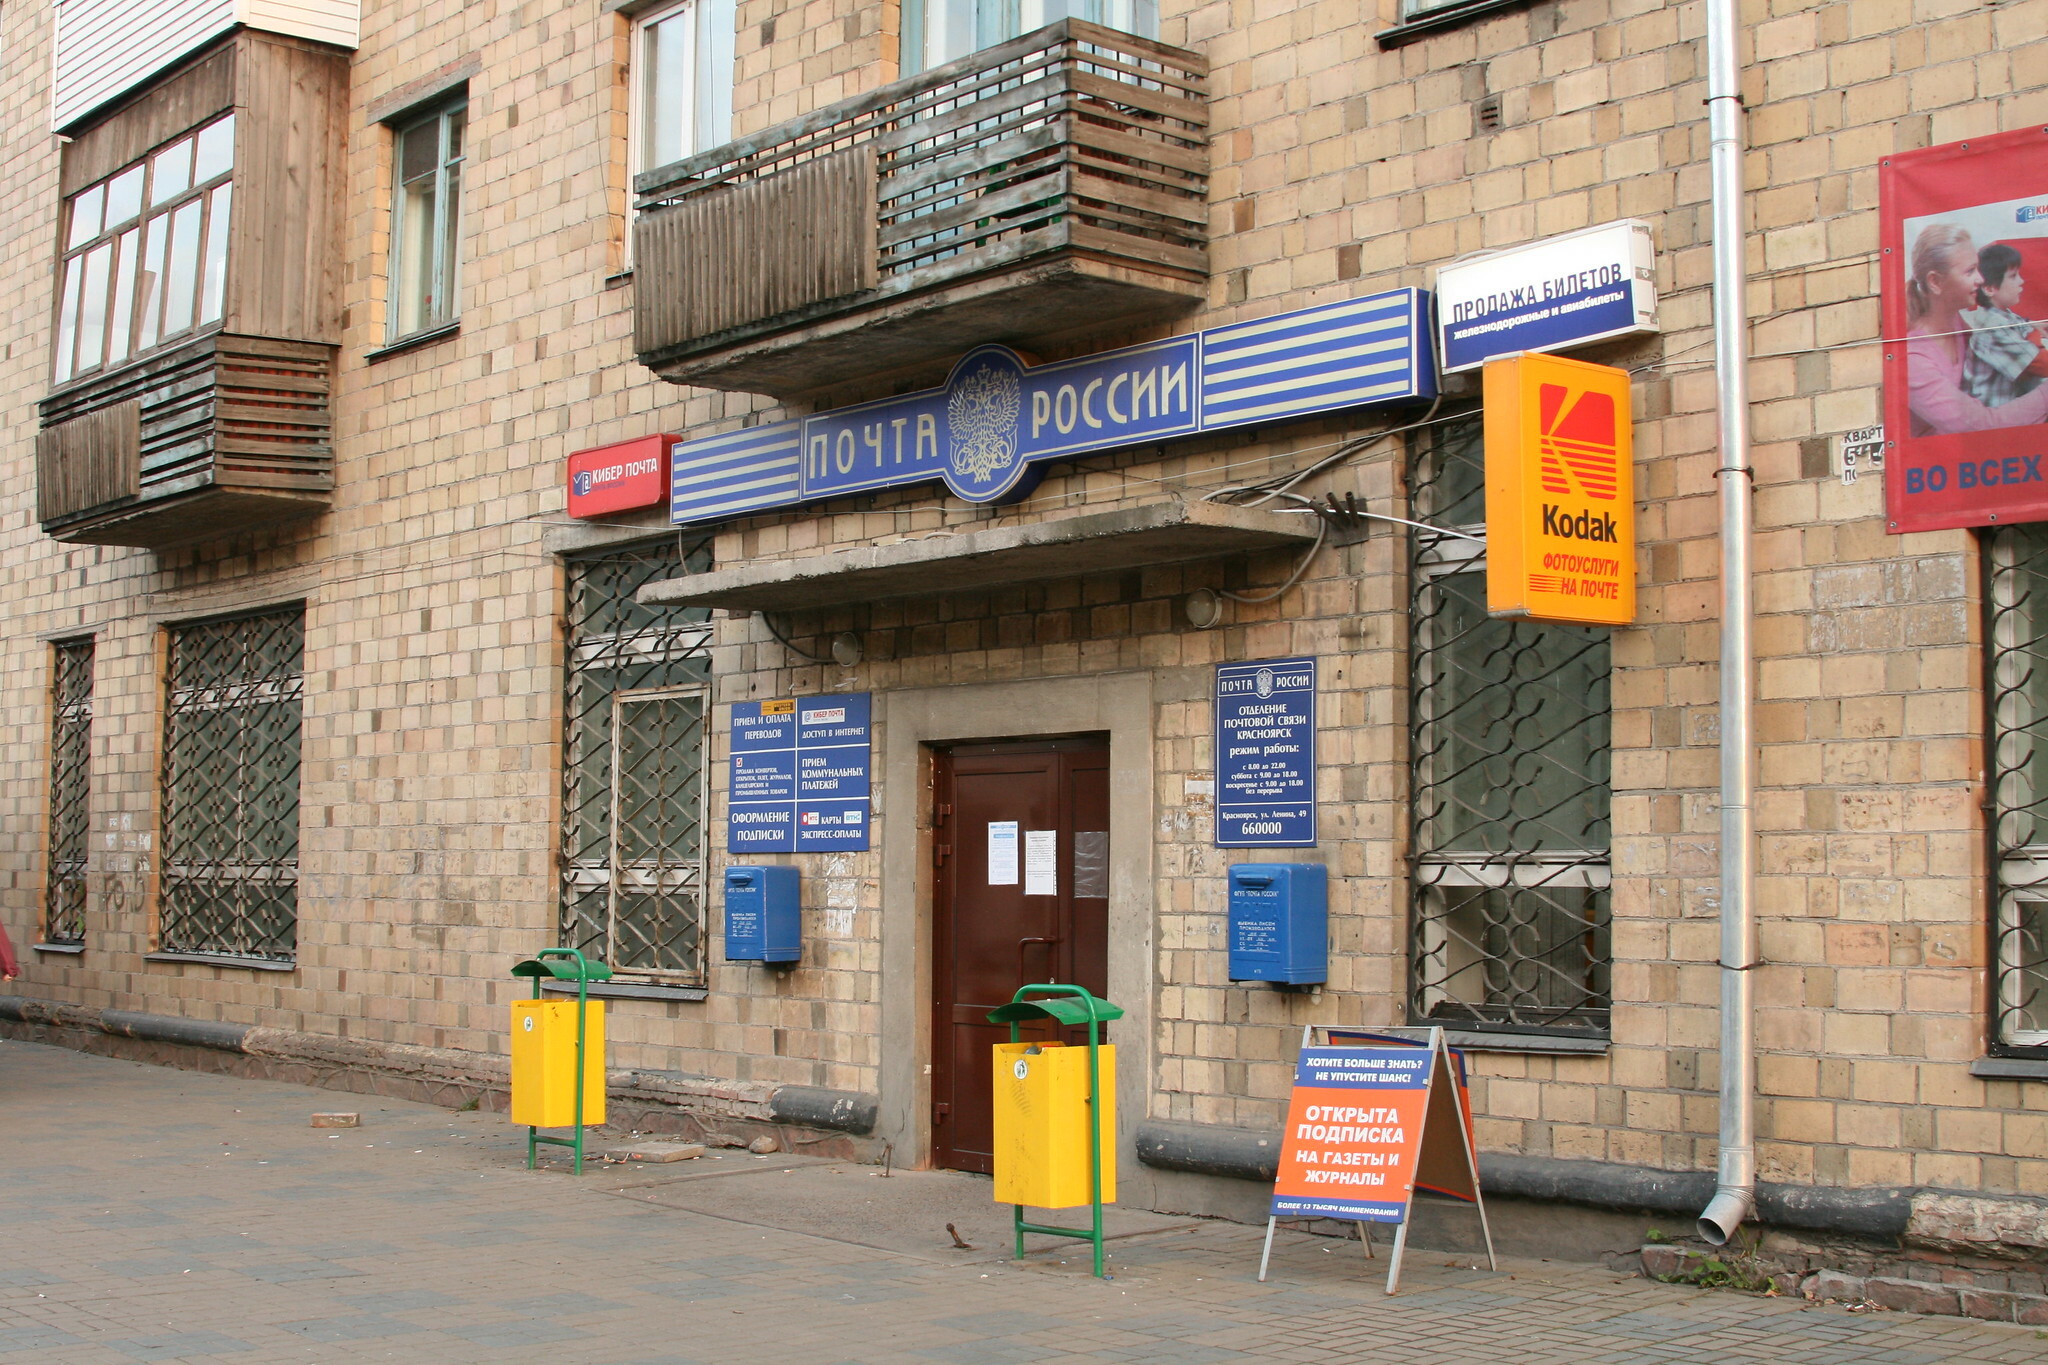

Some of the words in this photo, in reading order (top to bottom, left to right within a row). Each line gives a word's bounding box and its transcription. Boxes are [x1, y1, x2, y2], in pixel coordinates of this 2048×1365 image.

[1453, 285, 1536, 323] ПРОДАЖА
[1543, 263, 1622, 300] БИЛЕТОВ
[1454, 309, 1550, 340] железнодорожные
[1551, 306, 1559, 316] и
[1560, 290, 1624, 314] авиабилеты
[809, 413, 938, 479] ПОЧТА
[1032, 361, 1187, 438] РОССИИ
[592, 465, 622, 484] КИБЕР
[626, 458, 658, 477] ПОЧТА
[1906, 464, 1948, 494] ВО
[1958, 454, 2044, 489] ВСЕХ
[1542, 503, 1618, 544] Kodak
[1544, 552, 1619, 577] ФОТОУСЛУГИ
[1561, 577, 1577, 596] НА
[1580, 580, 1619, 600] ПОЧТЕ
[1222, 680, 1252, 692] ПОЧТА
[1276, 675, 1309, 687] РОССИИ
[1238, 704, 1287, 715] ОТДЕЛЕНИЕ
[734, 717, 756, 726] ПРИЕМ
[758, 716, 763, 724] И
[766, 714, 791, 724] ОПЛАТА
[1224, 715, 1274, 728] ПОЧТОВОЙ
[1278, 715, 1306, 726] СВЯЗИ
[745, 729, 782, 740] ПЕРЕВОДОВ
[802, 730, 826, 738] ДОСТУП
[835, 727, 865, 736] ИНТЕРНЕТ
[1237, 728, 1291, 740] КРАСНОЯРСК
[1230, 746, 1259, 758] режим
[1264, 743, 1299, 757] работы:
[802, 758, 826, 767] ПРИЕМ
[802, 767, 863, 778] КОММУНАЛЬНЫХ
[802, 779, 838, 790] ПЛАТЕЖЕЙ
[732, 812, 789, 824] ОФОРМЛЕНИЕ
[821, 816, 841, 824] КАРТЫ
[802, 830, 861, 839] ЭКСПРЕСС-ОПЛАТЫ
[1242, 822, 1282, 834] 660000
[737, 830, 784, 841] ПОДПИСКИ
[1306, 1058, 1343, 1068] ХОТИТЕ
[1344, 1058, 1385, 1068] БОЛЬШЕ
[1387, 1059, 1423, 1069] ЗНАТЬ?
[1315, 1071, 1328, 1081] НЕ
[1330, 1072, 1377, 1082] УПУСТИТЕ
[1379, 1073, 1411, 1083] ШАНС!
[1306, 1105, 1398, 1124] ОТКРЫТА
[1297, 1125, 1405, 1144] ПОДПИСКА
[1296, 1150, 1318, 1163] НА
[1323, 1152, 1384, 1166] ГАЗЕТЫ
[1388, 1154, 1399, 1166] И
[1304, 1170, 1385, 1186] ЖУРНАЛЫ
[1312, 1203, 1337, 1212] ТЫСЯЧ
[1339, 1205, 1399, 1217] НАИМЕНОВАНИЙ
